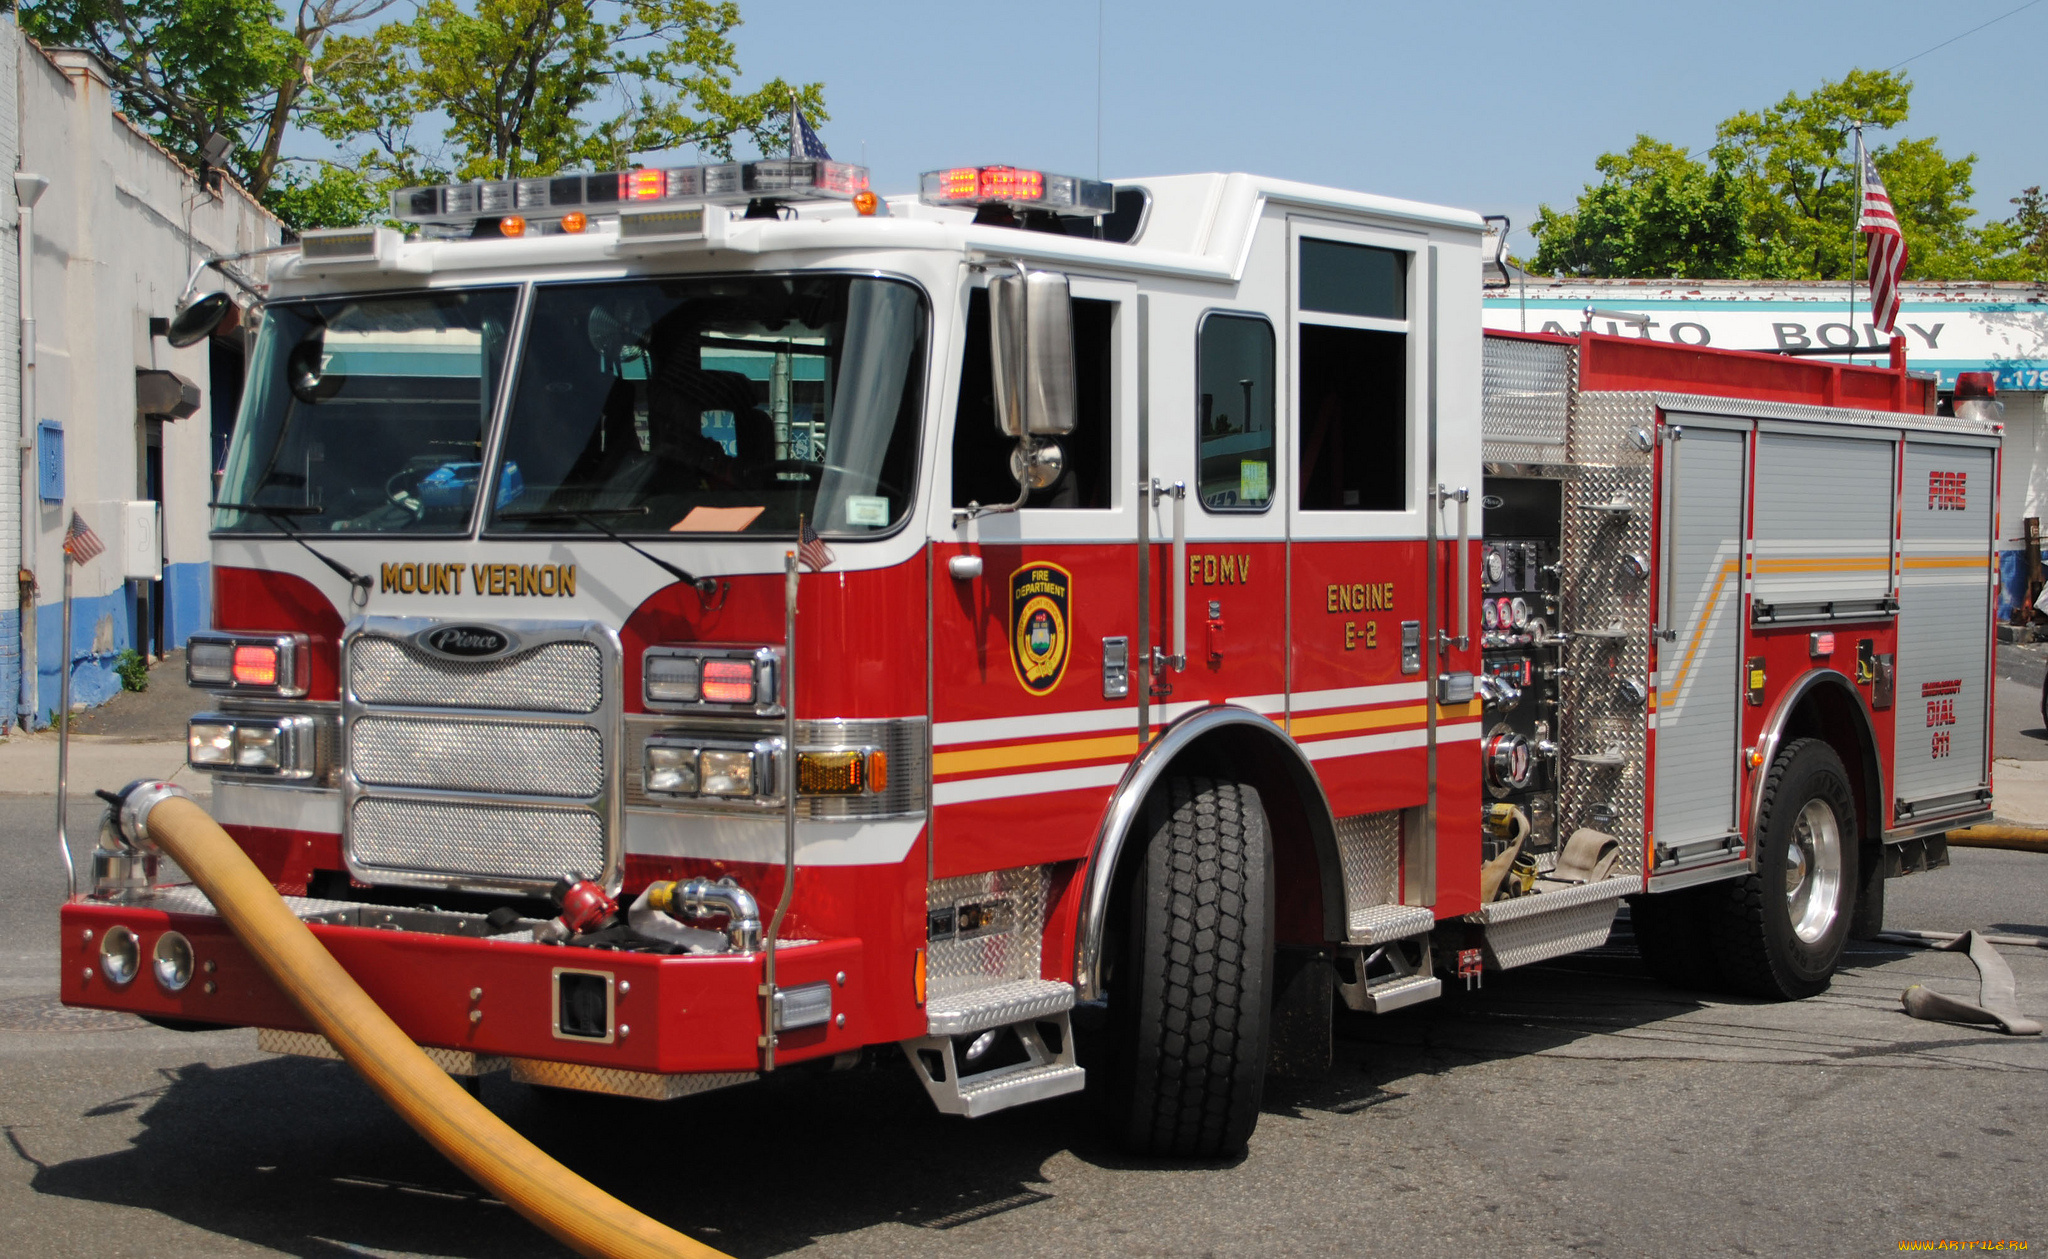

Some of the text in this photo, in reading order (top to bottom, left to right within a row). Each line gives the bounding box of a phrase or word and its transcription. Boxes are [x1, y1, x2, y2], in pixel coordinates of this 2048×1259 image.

[1772, 323, 1945, 349] BODY
[1928, 471, 1966, 510] FIRE
[381, 562, 576, 597] MOUNT VERNON
[1031, 570, 1049, 581] FIRE
[1189, 554, 1250, 585] FDMV
[1015, 582, 1065, 599] DEPARTMENT
[1327, 582, 1394, 614] ENGINE
[438, 629, 498, 649] Pierce
[1345, 620, 1377, 650] E-2
[1926, 699, 1956, 728] DIAL
[1932, 731, 1949, 759] 911
